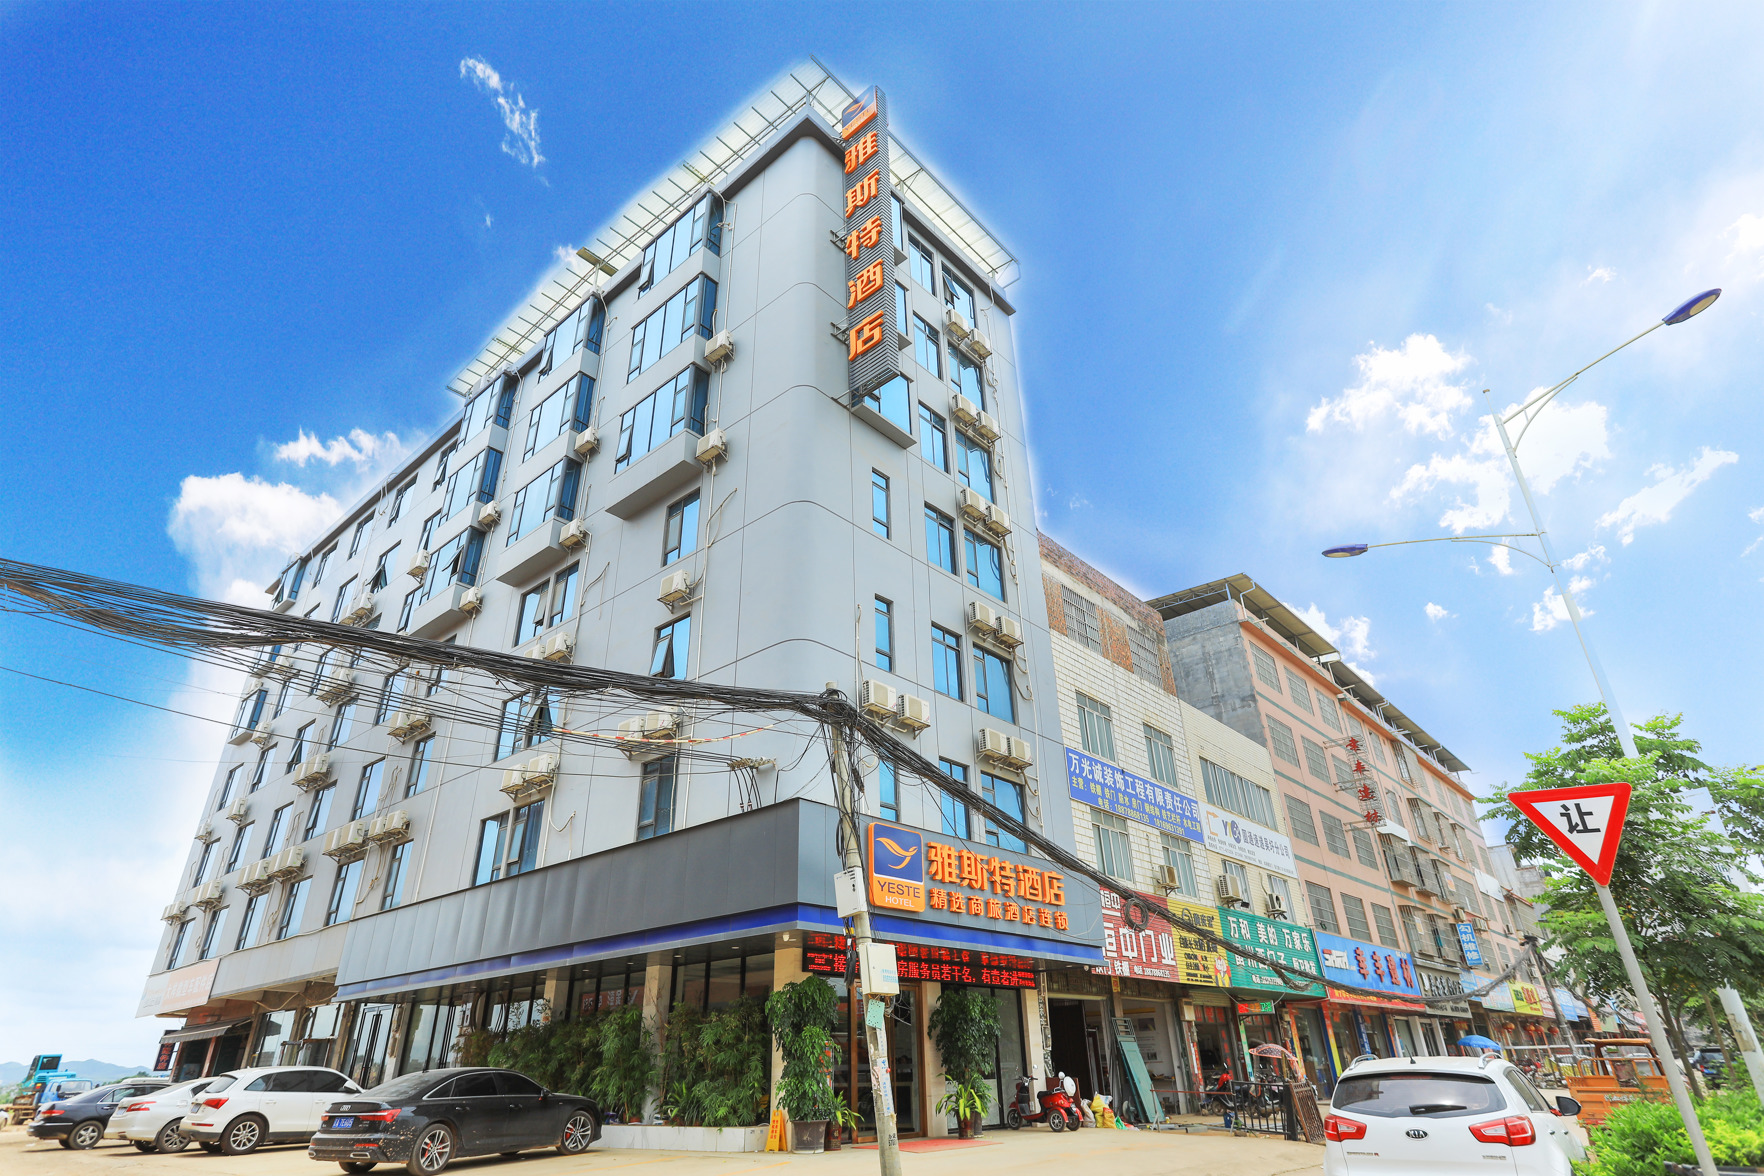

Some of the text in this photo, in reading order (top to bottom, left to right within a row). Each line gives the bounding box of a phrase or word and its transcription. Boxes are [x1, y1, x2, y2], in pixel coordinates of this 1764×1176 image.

[844, 130, 884, 362] 雅斯特酒店
[1559, 803, 1601, 834] 让
[877, 880, 921, 899] YESTE
[927, 841, 1067, 906] 雅斯特酒店
[885, 895, 915, 908] HOTEL
[929, 887, 1069, 931] 精选商旅酒店连锁
[1227, 916, 1251, 940] 万和
[1256, 921, 1278, 946] 美的
[1282, 928, 1312, 952] 万家乐
[1459, 925, 1480, 961] 勾机维修
[1407, 1129, 1425, 1138] KIA
